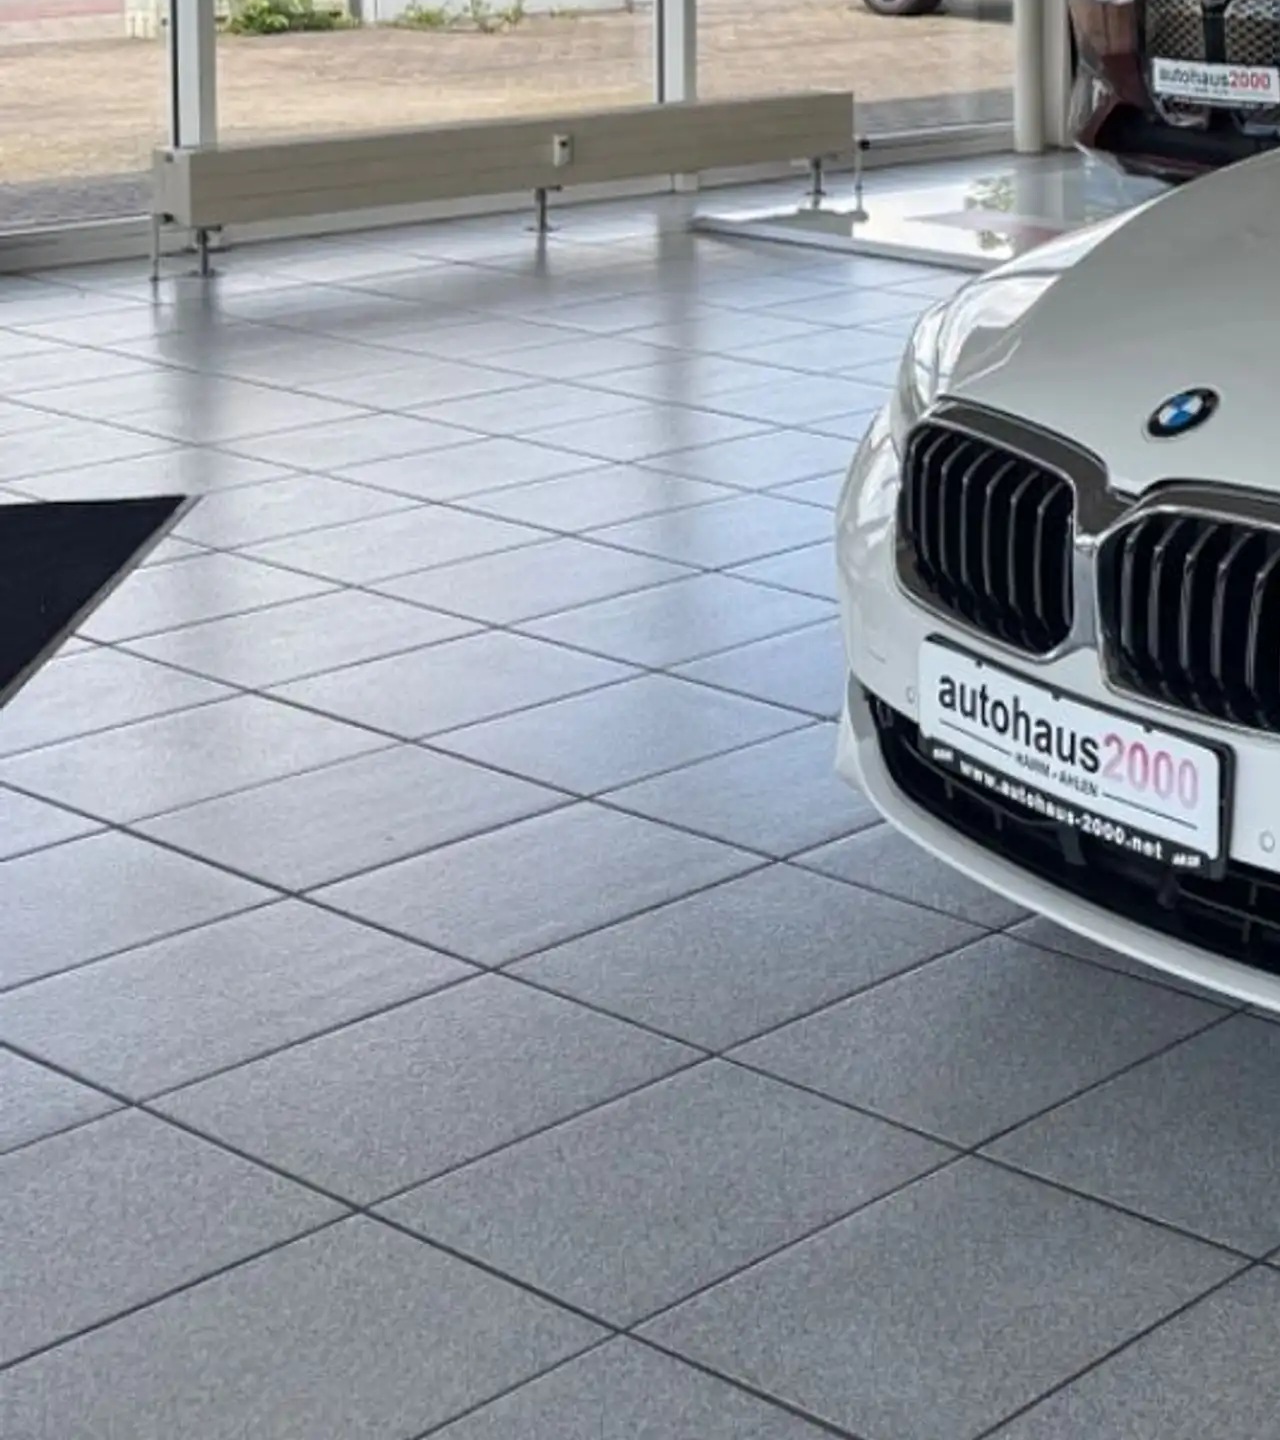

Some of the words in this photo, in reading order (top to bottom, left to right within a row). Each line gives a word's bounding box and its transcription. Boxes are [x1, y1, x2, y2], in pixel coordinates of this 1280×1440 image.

[1157, 64, 1272, 91] autohaus2000
[938, 673, 1200, 811] autohaus2000
[958, 760, 1164, 860] www.autohaus-2000.net
